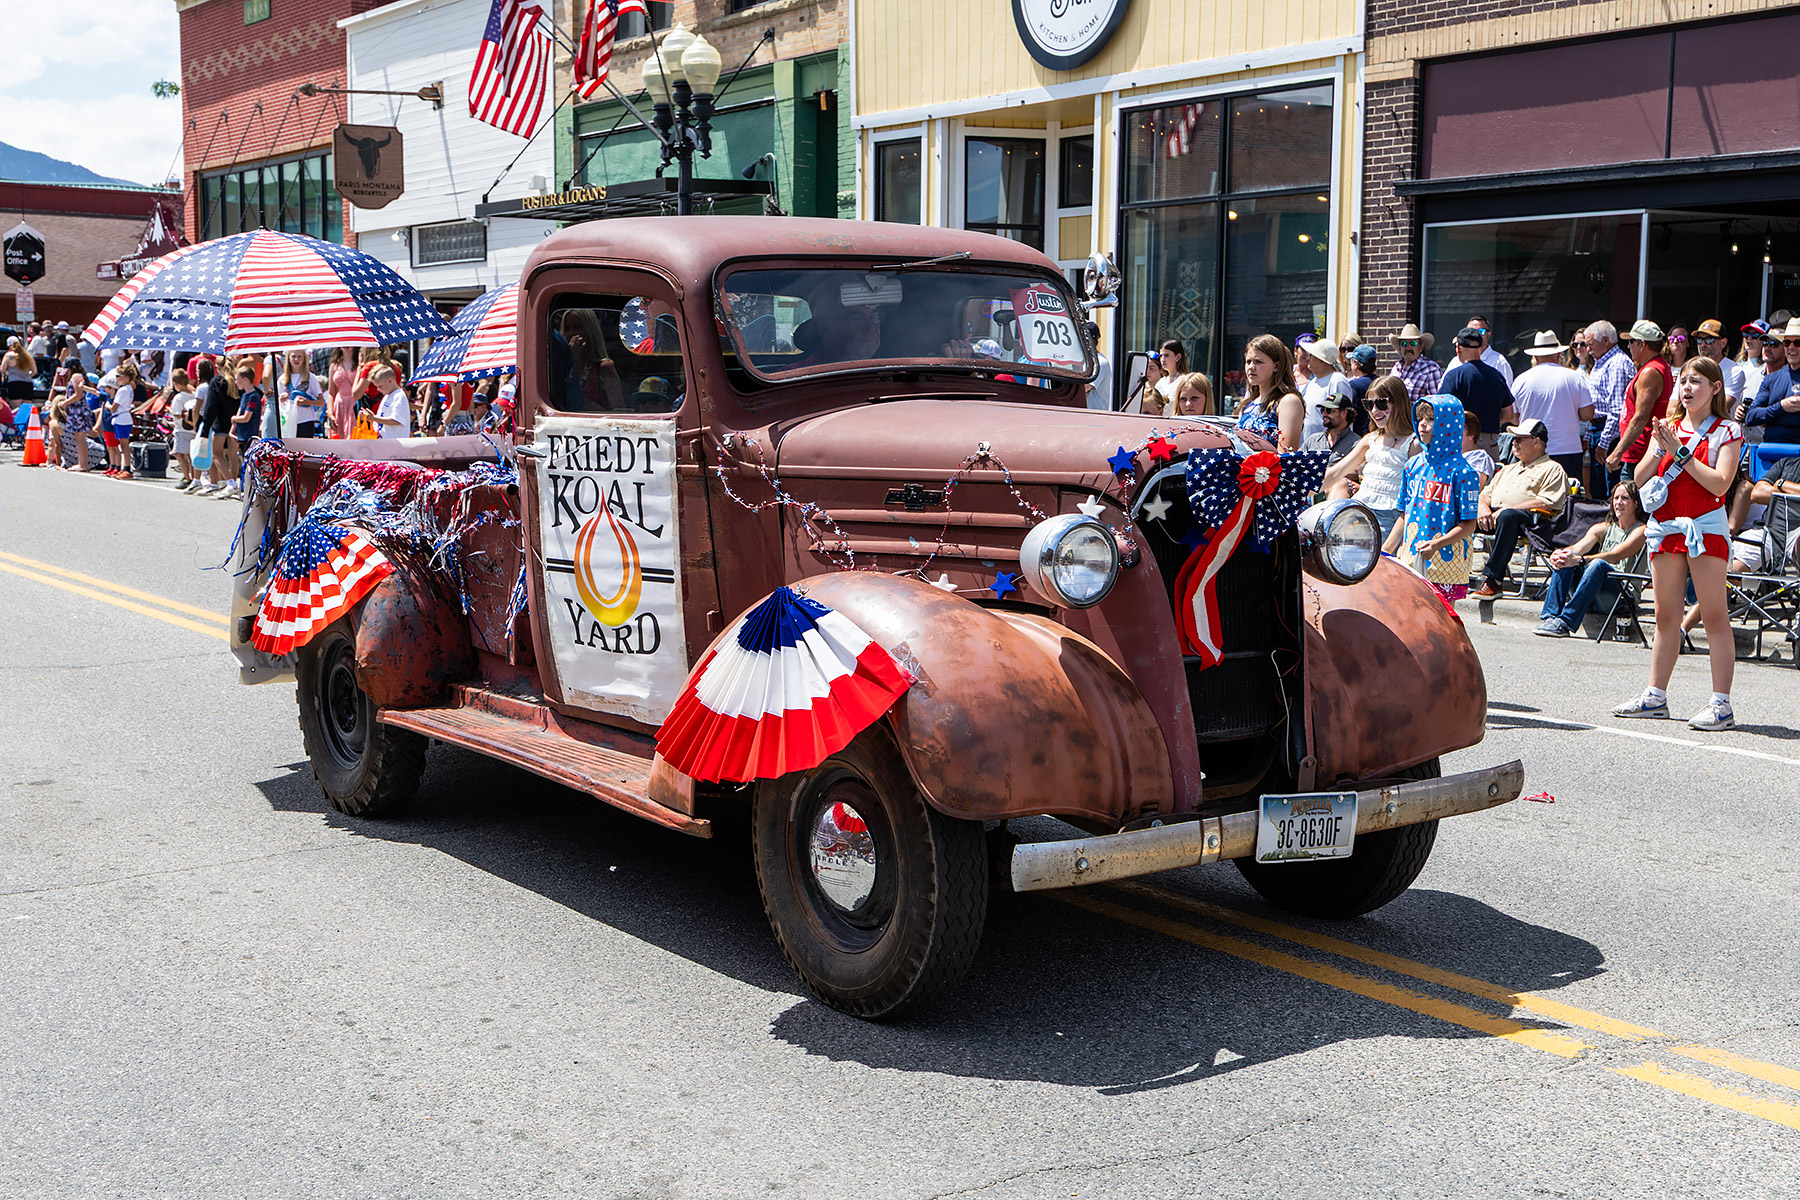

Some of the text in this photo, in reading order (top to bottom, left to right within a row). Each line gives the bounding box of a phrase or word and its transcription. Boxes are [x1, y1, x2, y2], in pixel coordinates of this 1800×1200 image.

[1039, 13, 1100, 43] KITCHEN & HOME
[362, 182, 401, 190] MONTANA
[522, 193, 558, 210] FOSTER
[558, 192, 565, 205] &
[7, 257, 28, 265] Office
[1025, 290, 1065, 312] Justin
[1034, 320, 1072, 346] 203
[547, 434, 659, 474] FRIEDT
[1424, 481, 1451, 503] SZN
[548, 474, 664, 539] KOAL
[563, 598, 661, 655] YARD
[1290, 799, 1333, 816] MONTANA
[1277, 816, 1343, 849] 3C 8630F
